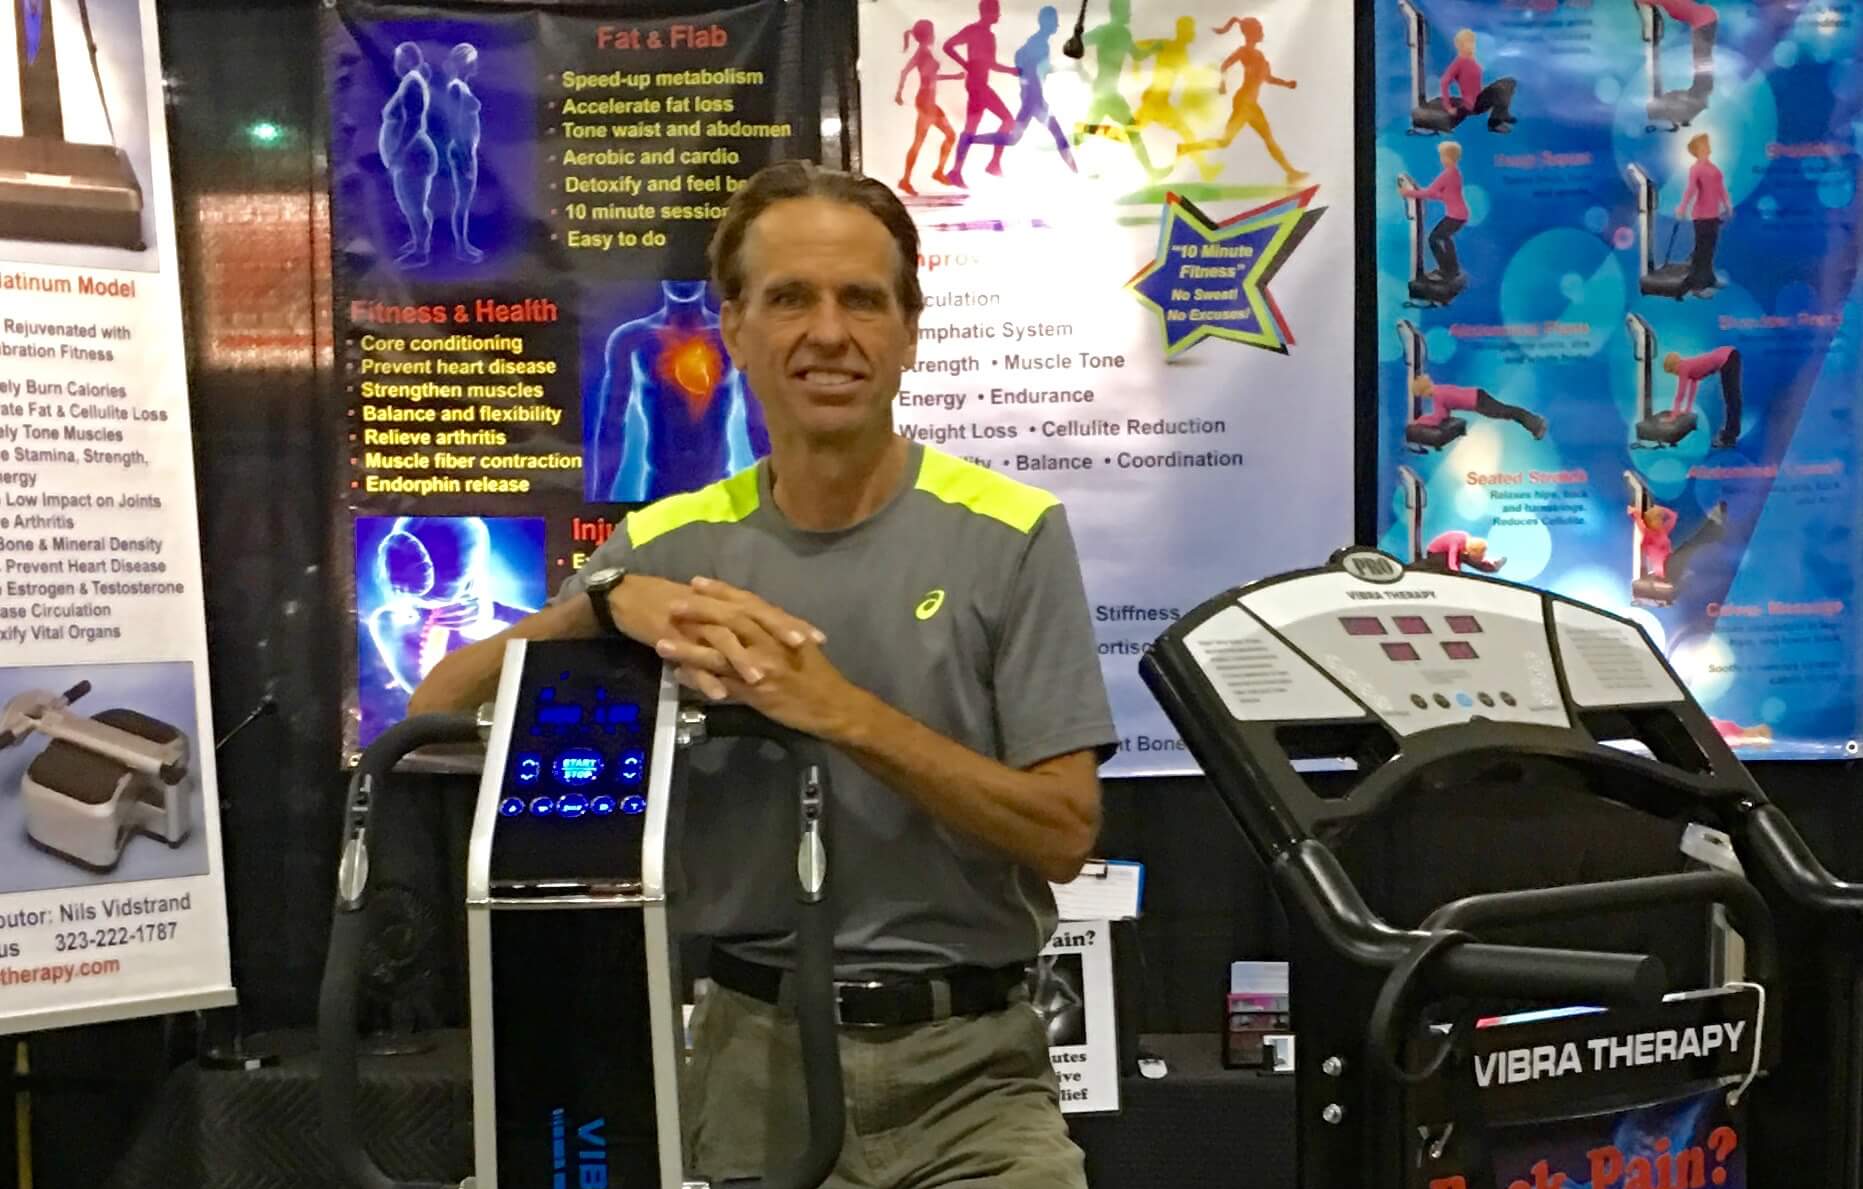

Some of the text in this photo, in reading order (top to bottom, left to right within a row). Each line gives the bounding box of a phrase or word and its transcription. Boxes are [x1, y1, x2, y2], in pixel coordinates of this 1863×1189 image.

[596, 25, 728, 50] Fat & Flab
[562, 69, 763, 90] Speed-up metabolism
[562, 97, 734, 114] Accelerate fat loss
[562, 121, 791, 138] Tone waist and abdomen
[563, 148, 739, 165] Aerobic and cardio
[565, 176, 641, 196] Detoxify
[648, 176, 681, 191] and
[687, 176, 720, 191] feel
[566, 203, 586, 219] 10
[592, 203, 655, 219] minute
[568, 231, 666, 250] Easy to do
[1201, 244, 1254, 258] Minute
[79, 276, 136, 298] Model
[1171, 289, 1191, 301] No
[351, 298, 558, 324] Fitness & Health
[1167, 309, 1187, 321] No
[4, 318, 131, 340] Rejuvenated with
[1002, 320, 1073, 340] System
[60, 344, 114, 361] Fitness
[360, 334, 523, 354] Core conditioning
[361, 358, 556, 375] Prevent heart disease
[1004, 354, 1072, 371] Muscle
[1079, 352, 1125, 368] Tone
[26, 379, 62, 395] Burn
[67, 381, 127, 398] Calories
[361, 382, 544, 401] Strengthen muscles
[899, 388, 1094, 409] Energy Endurance
[28, 402, 52, 418] Fat
[56, 405, 66, 418] &
[70, 403, 129, 420] Cellulite
[132, 407, 168, 422] Loss
[363, 405, 562, 425] Balance and flexibility
[23, 424, 60, 441] Tone
[63, 426, 124, 442] Muscles
[364, 429, 506, 445] Relieve arthritis
[899, 418, 1226, 444] Weight Loss Cellulite Reduction
[14, 446, 79, 465] Stamina,
[83, 448, 149, 468] Strength,
[365, 452, 583, 469] Muscle fiber contraction
[1016, 450, 1243, 471] Balance Coordination
[366, 475, 529, 495] Endorphin release
[1467, 471, 1523, 485] Seated
[6, 492, 162, 509] Low Impact on Joints
[14, 514, 74, 529] Arthritis
[38, 538, 48, 550] &
[52, 536, 105, 551] Mineral
[110, 536, 163, 554] Density
[6, 558, 166, 574] Prevent Heart Disease
[1352, 557, 1394, 575] PRO
[7, 581, 75, 599] Estrogen
[80, 582, 88, 596] &
[92, 580, 185, 595] Testosterone
[31, 602, 111, 618] Circulation
[1096, 605, 1180, 622] Stiffness
[31, 625, 64, 640] Vital
[69, 624, 121, 642] Organs
[60, 902, 96, 923] Nils
[101, 892, 192, 918] Vidstrand
[55, 921, 178, 951] 323-222-1787
[0, 957, 120, 986] therapy.com
[1474, 1020, 1746, 1087] VIBRA THERAPY
